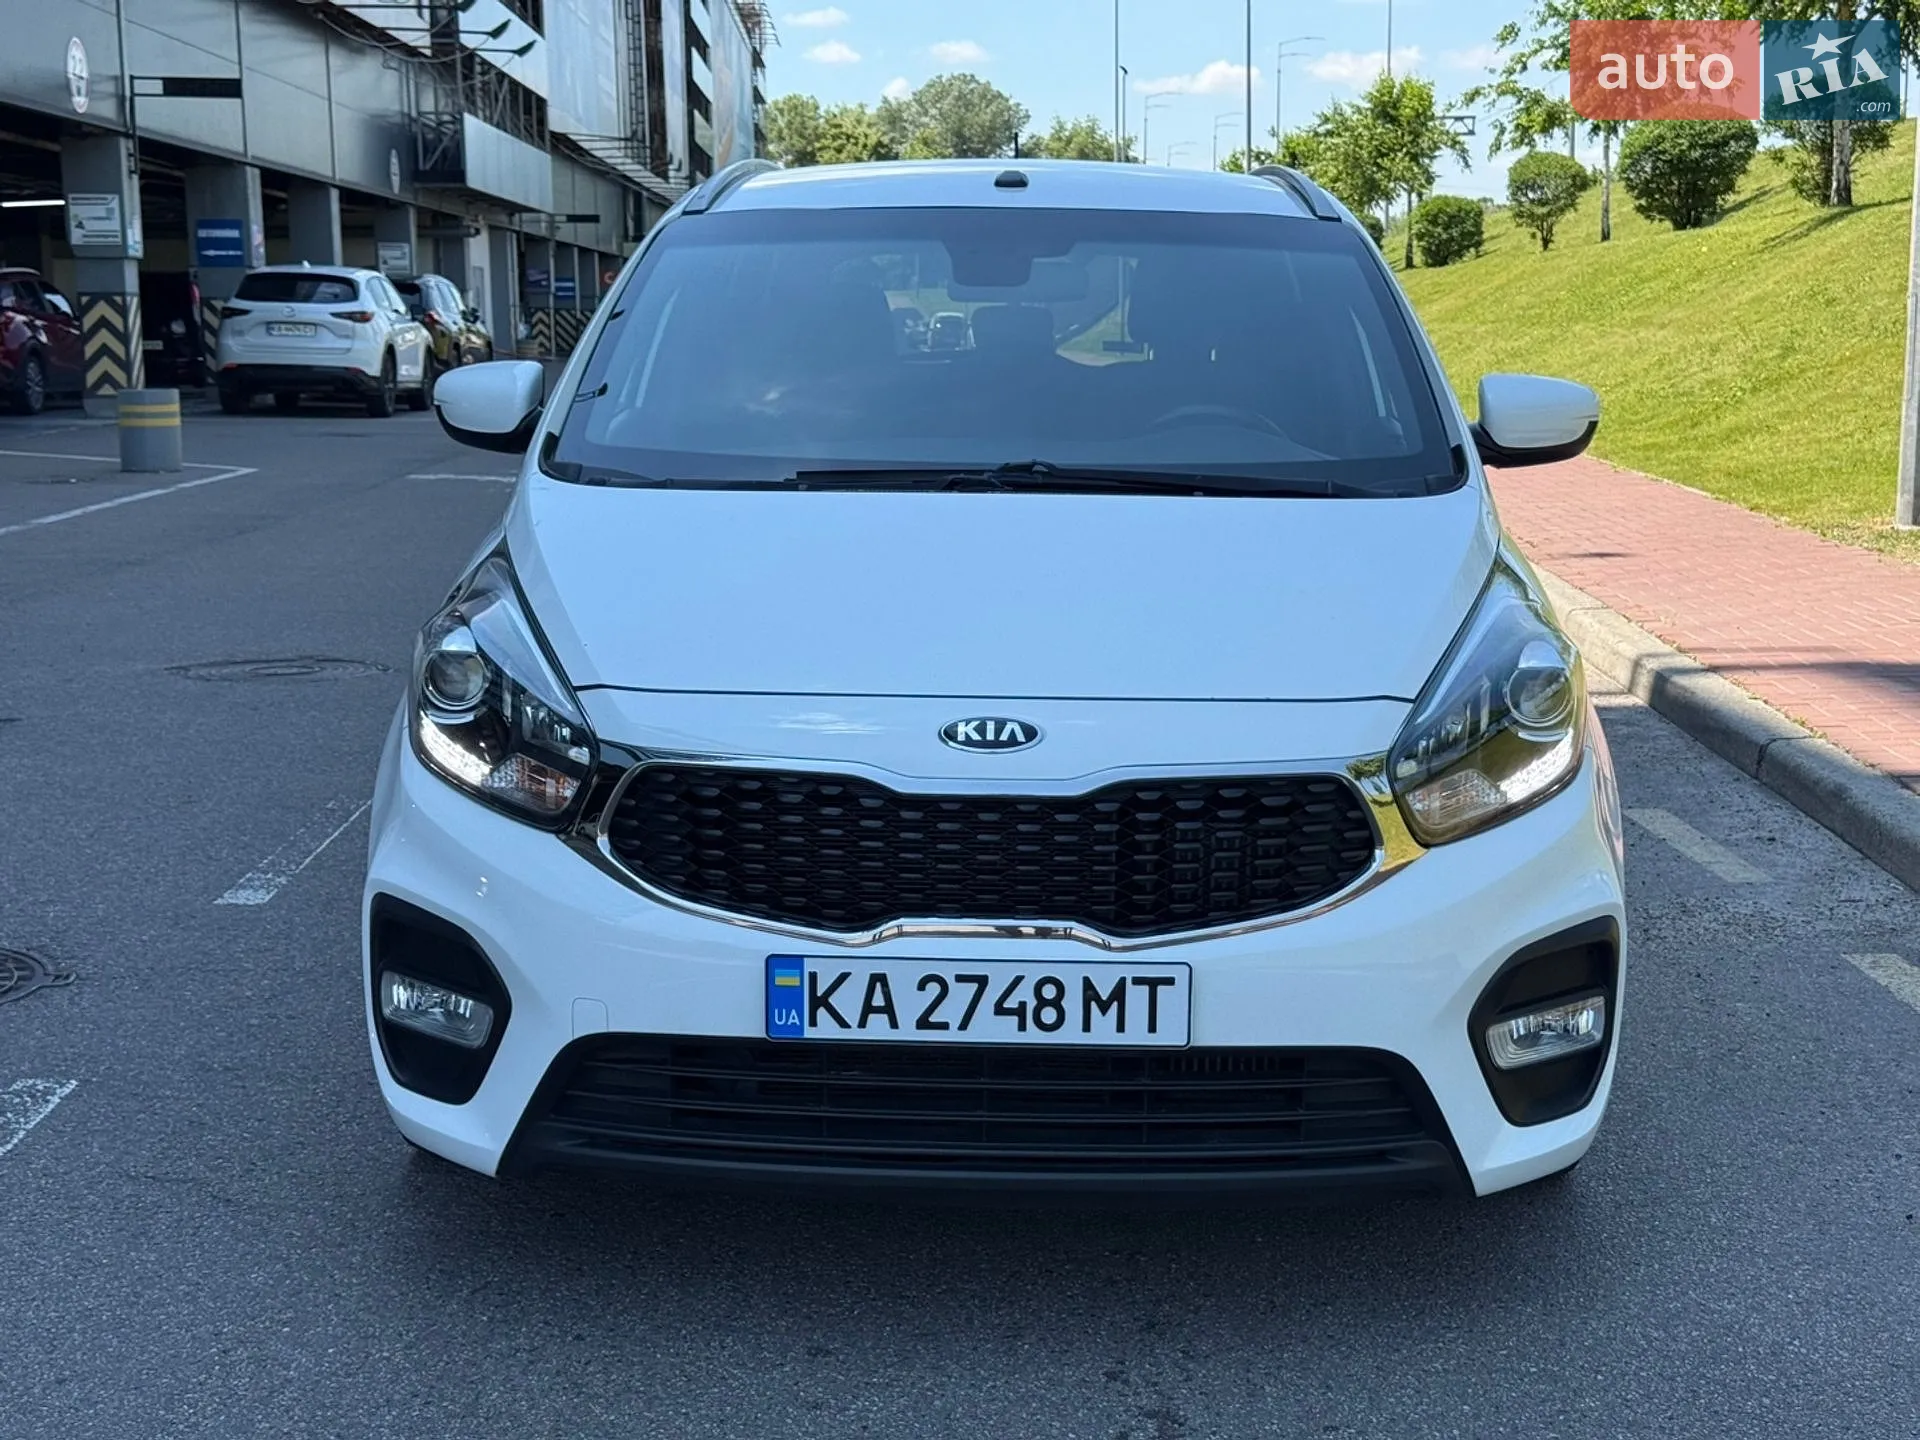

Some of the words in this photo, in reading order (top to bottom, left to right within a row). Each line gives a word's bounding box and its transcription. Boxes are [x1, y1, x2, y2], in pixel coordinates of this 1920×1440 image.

[957, 720, 1026, 742] KIA
[807, 971, 900, 1030] KA
[915, 973, 1066, 1033] 2748
[1081, 975, 1176, 1034] MT
[774, 1008, 800, 1026] UA
